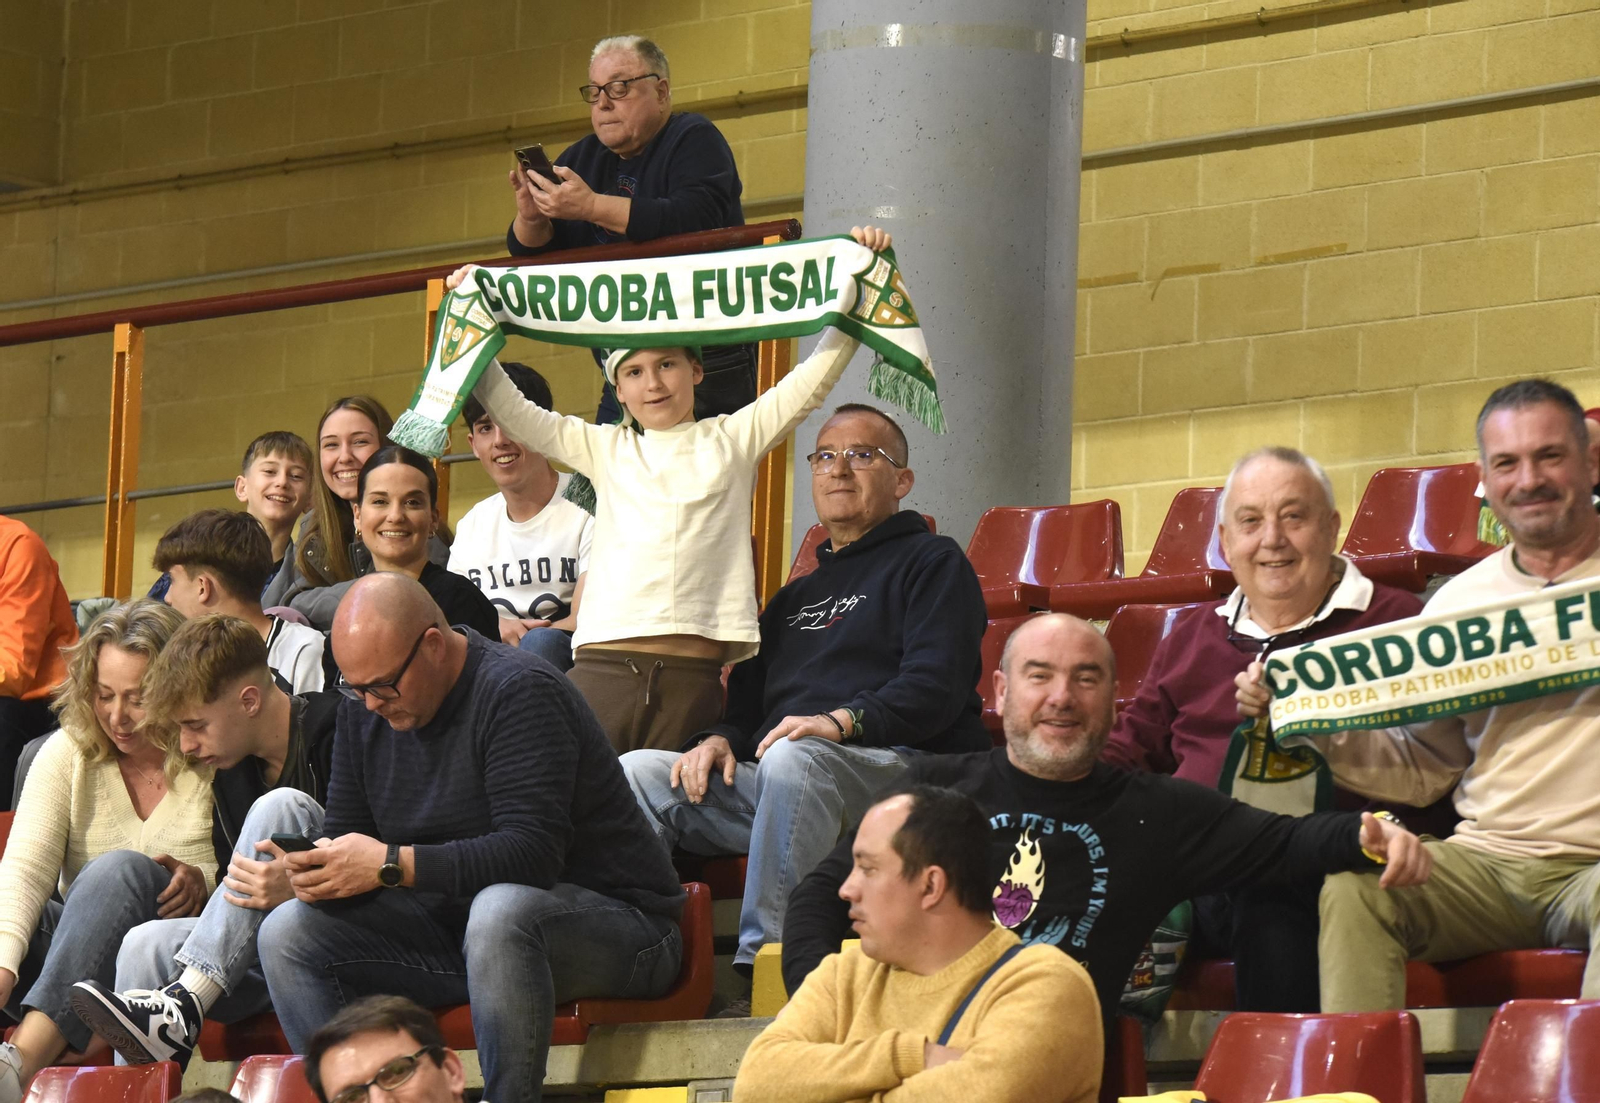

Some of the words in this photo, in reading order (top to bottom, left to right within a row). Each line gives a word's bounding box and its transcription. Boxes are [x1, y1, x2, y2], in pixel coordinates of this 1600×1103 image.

[475, 265, 678, 322] CÓRDOBA
[692, 255, 840, 319] FUTSAL
[468, 557, 577, 590] SILBON
[1265, 607, 1537, 699] CÓRDOBA
[1272, 688, 1379, 721] CÓRDOBA
[1391, 653, 1534, 698] PATRIMONIO
[1548, 645, 1577, 665] DE
[1426, 698, 1461, 714] 2019
[1470, 689, 1507, 706] 2020
[1020, 812, 1056, 835] IT'S
[1091, 866, 1110, 895] I'M
[1070, 898, 1106, 949] YOURS
